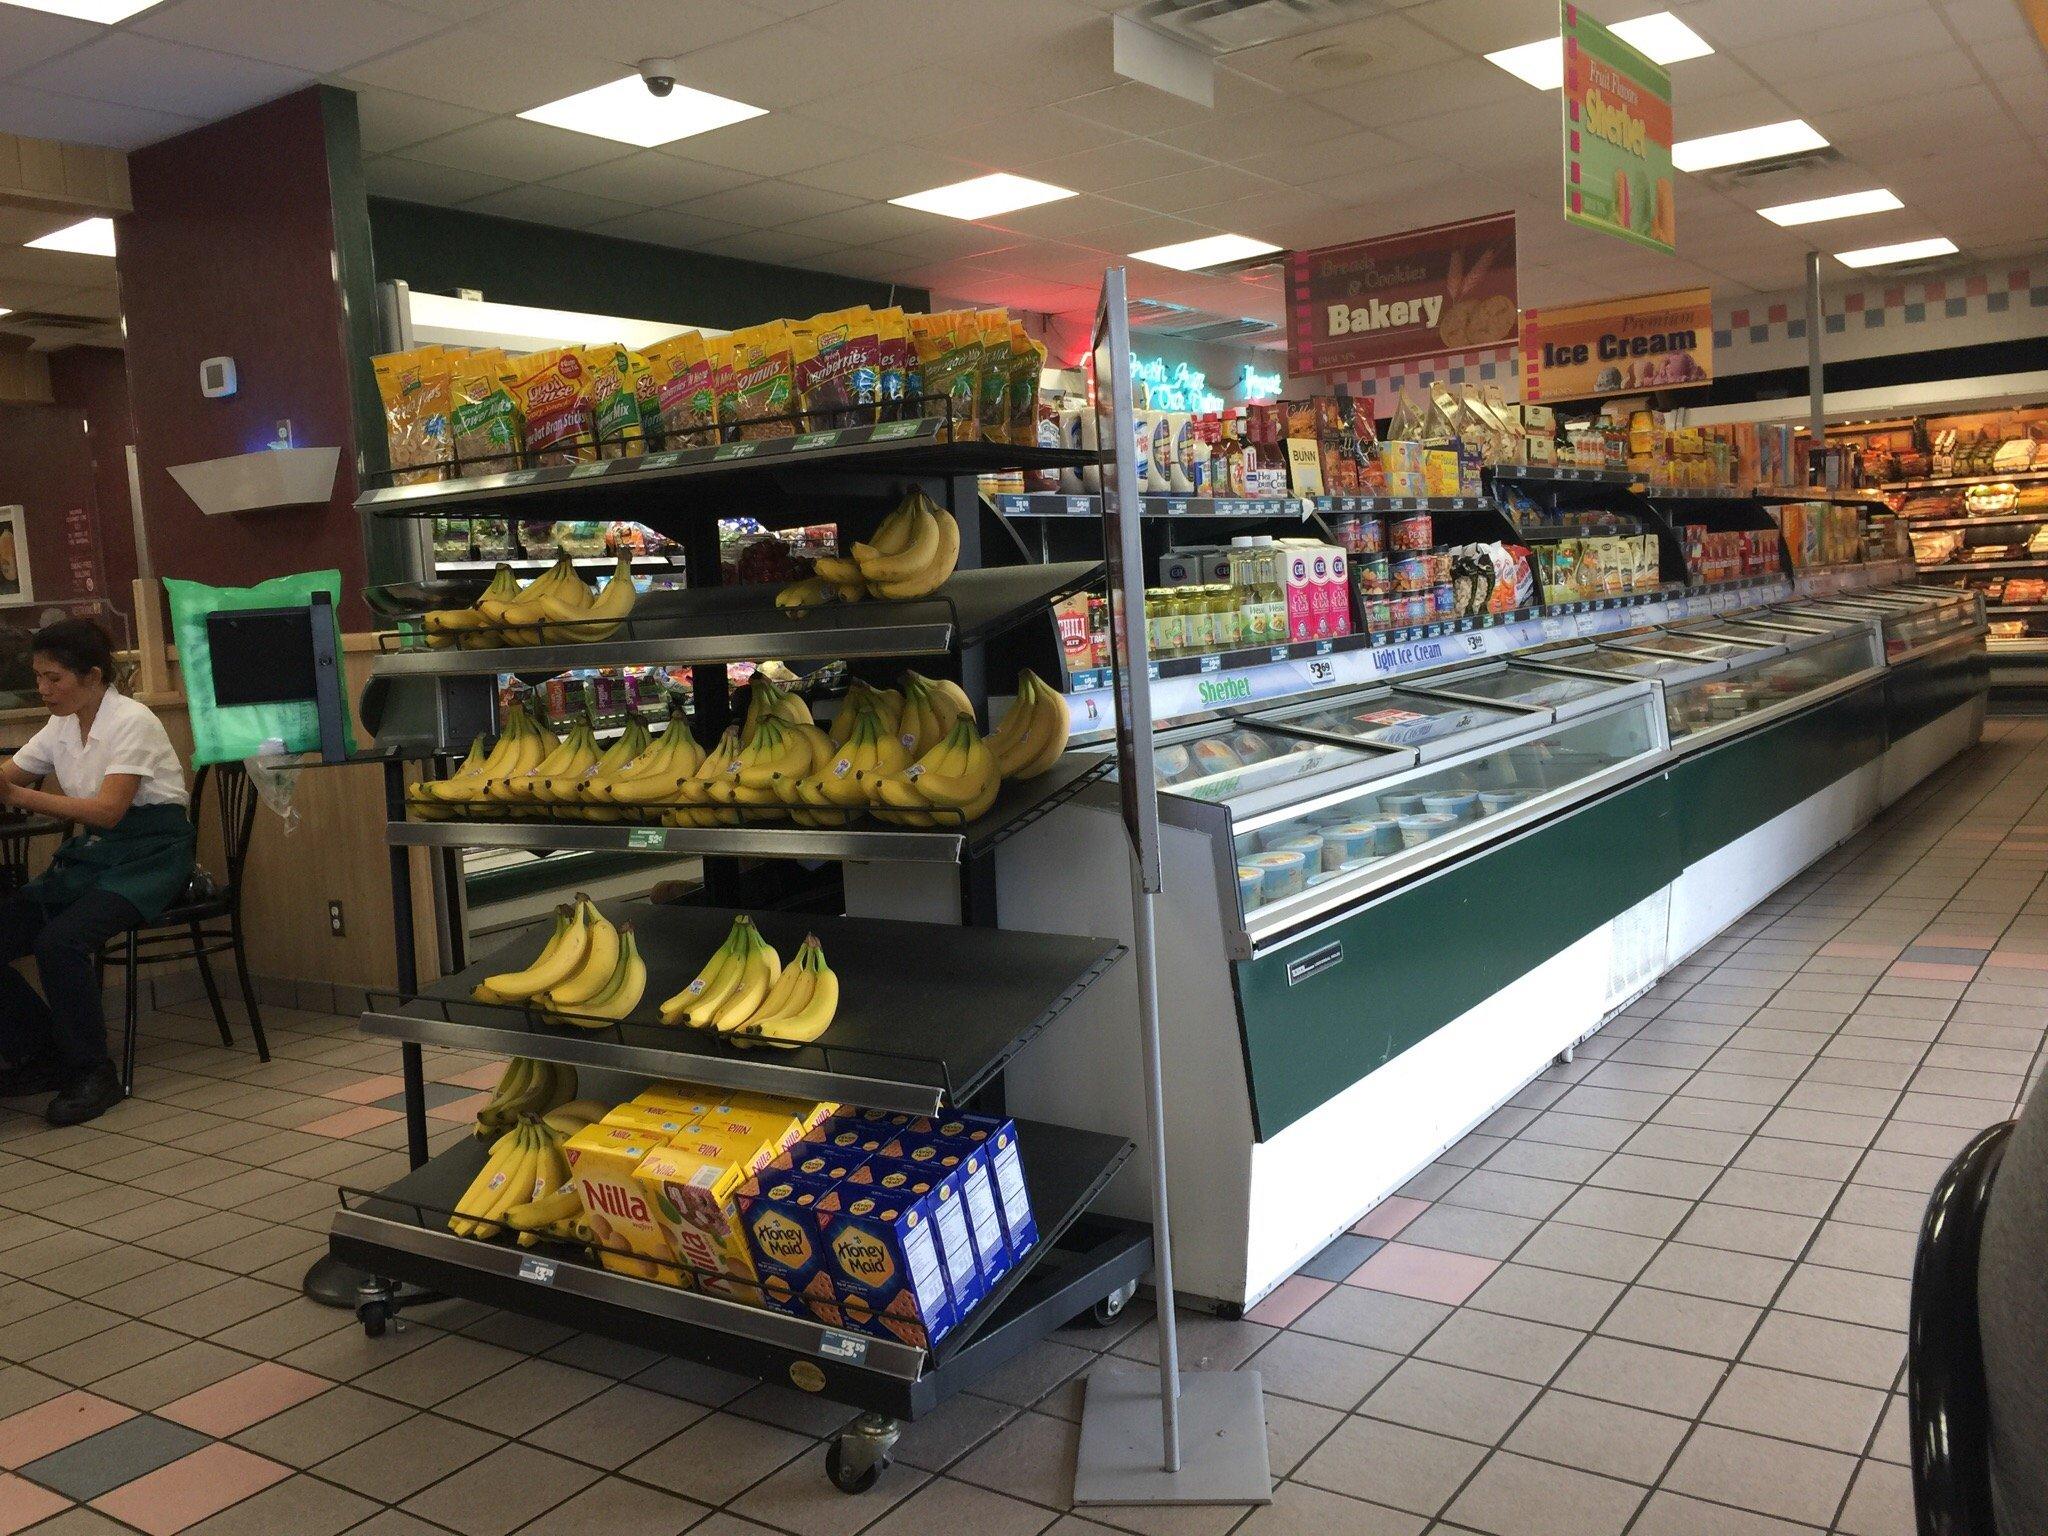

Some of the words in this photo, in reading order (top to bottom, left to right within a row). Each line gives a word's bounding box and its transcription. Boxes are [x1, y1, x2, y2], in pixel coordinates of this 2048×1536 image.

[1590, 59, 1610, 91] Fruit
[1586, 88, 1647, 161] Sherbet
[1328, 295, 1443, 336] Bakery
[1622, 311, 1695, 332] Premium
[1543, 341, 1589, 368] Ice
[1599, 329, 1697, 361] Cream
[564, 409, 586, 428] Sticks
[614, 402, 630, 418] Mix
[1292, 450, 1316, 462] BUNN
[1058, 617, 1086, 641] CHILI
[1373, 648, 1397, 671] Light
[1398, 648, 1412, 664] Ice
[1414, 643, 1442, 662] Cream
[1198, 676, 1252, 703] Sherbet
[811, 1106, 831, 1130] Nilla
[698, 1144, 722, 1158] Nilla
[781, 1128, 802, 1152] Nilla
[651, 1162, 677, 1178] Nilla
[752, 1149, 773, 1174] Nilla
[582, 1179, 652, 1223] Nilla
[758, 1225, 802, 1245] Honey
[769, 1240, 804, 1256] Maid
[838, 1242, 885, 1262] Honey
[848, 1258, 886, 1275] Maid
